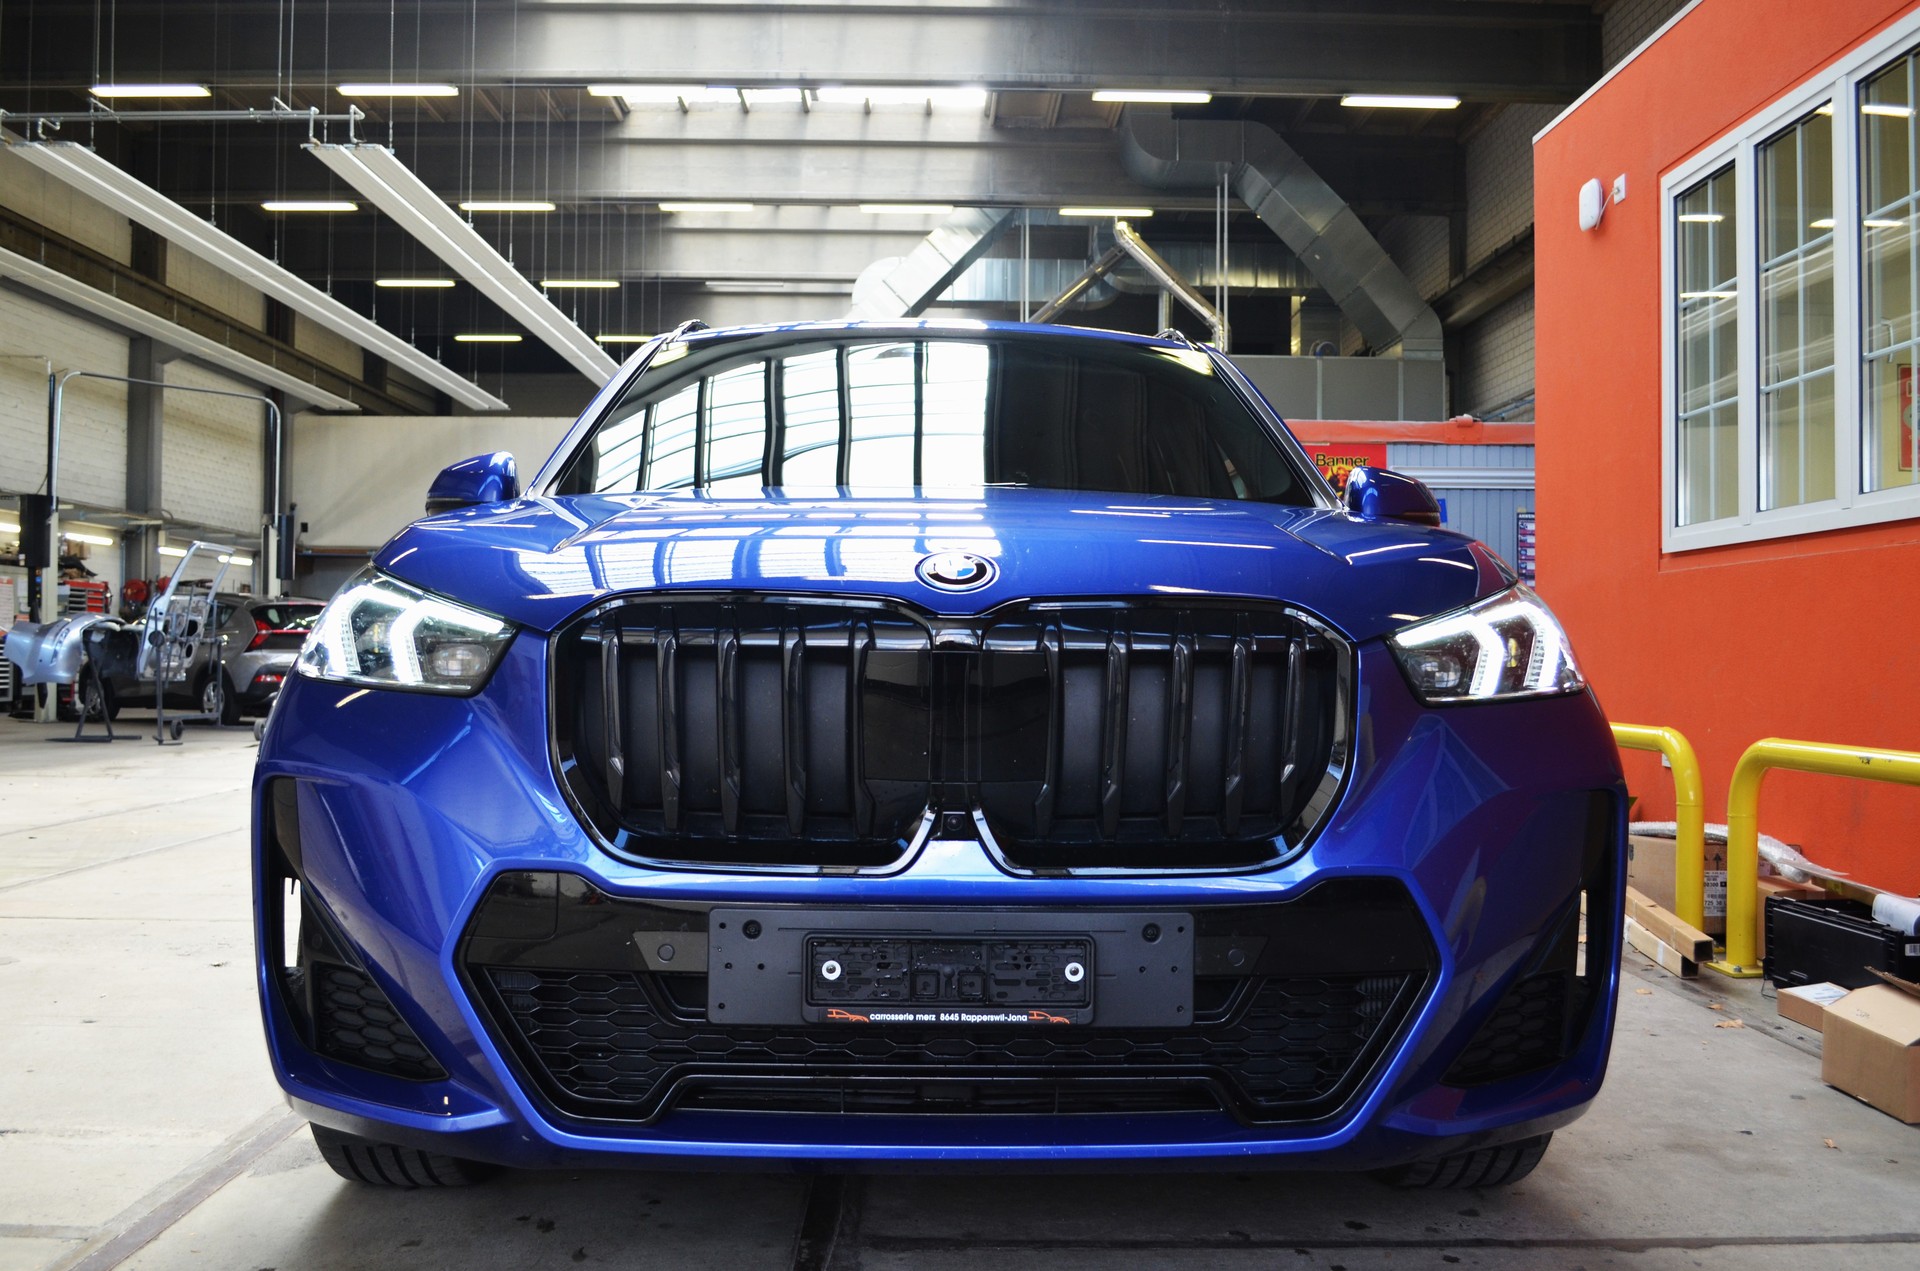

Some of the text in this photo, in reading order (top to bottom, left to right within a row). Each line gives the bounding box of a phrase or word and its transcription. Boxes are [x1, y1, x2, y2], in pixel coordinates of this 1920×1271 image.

[1315, 453, 1369, 467] Banner
[869, 1012, 914, 1021] carrosserie
[940, 1012, 959, 1021] 8645
[961, 1013, 1028, 1023] Rapperswil-Jona
